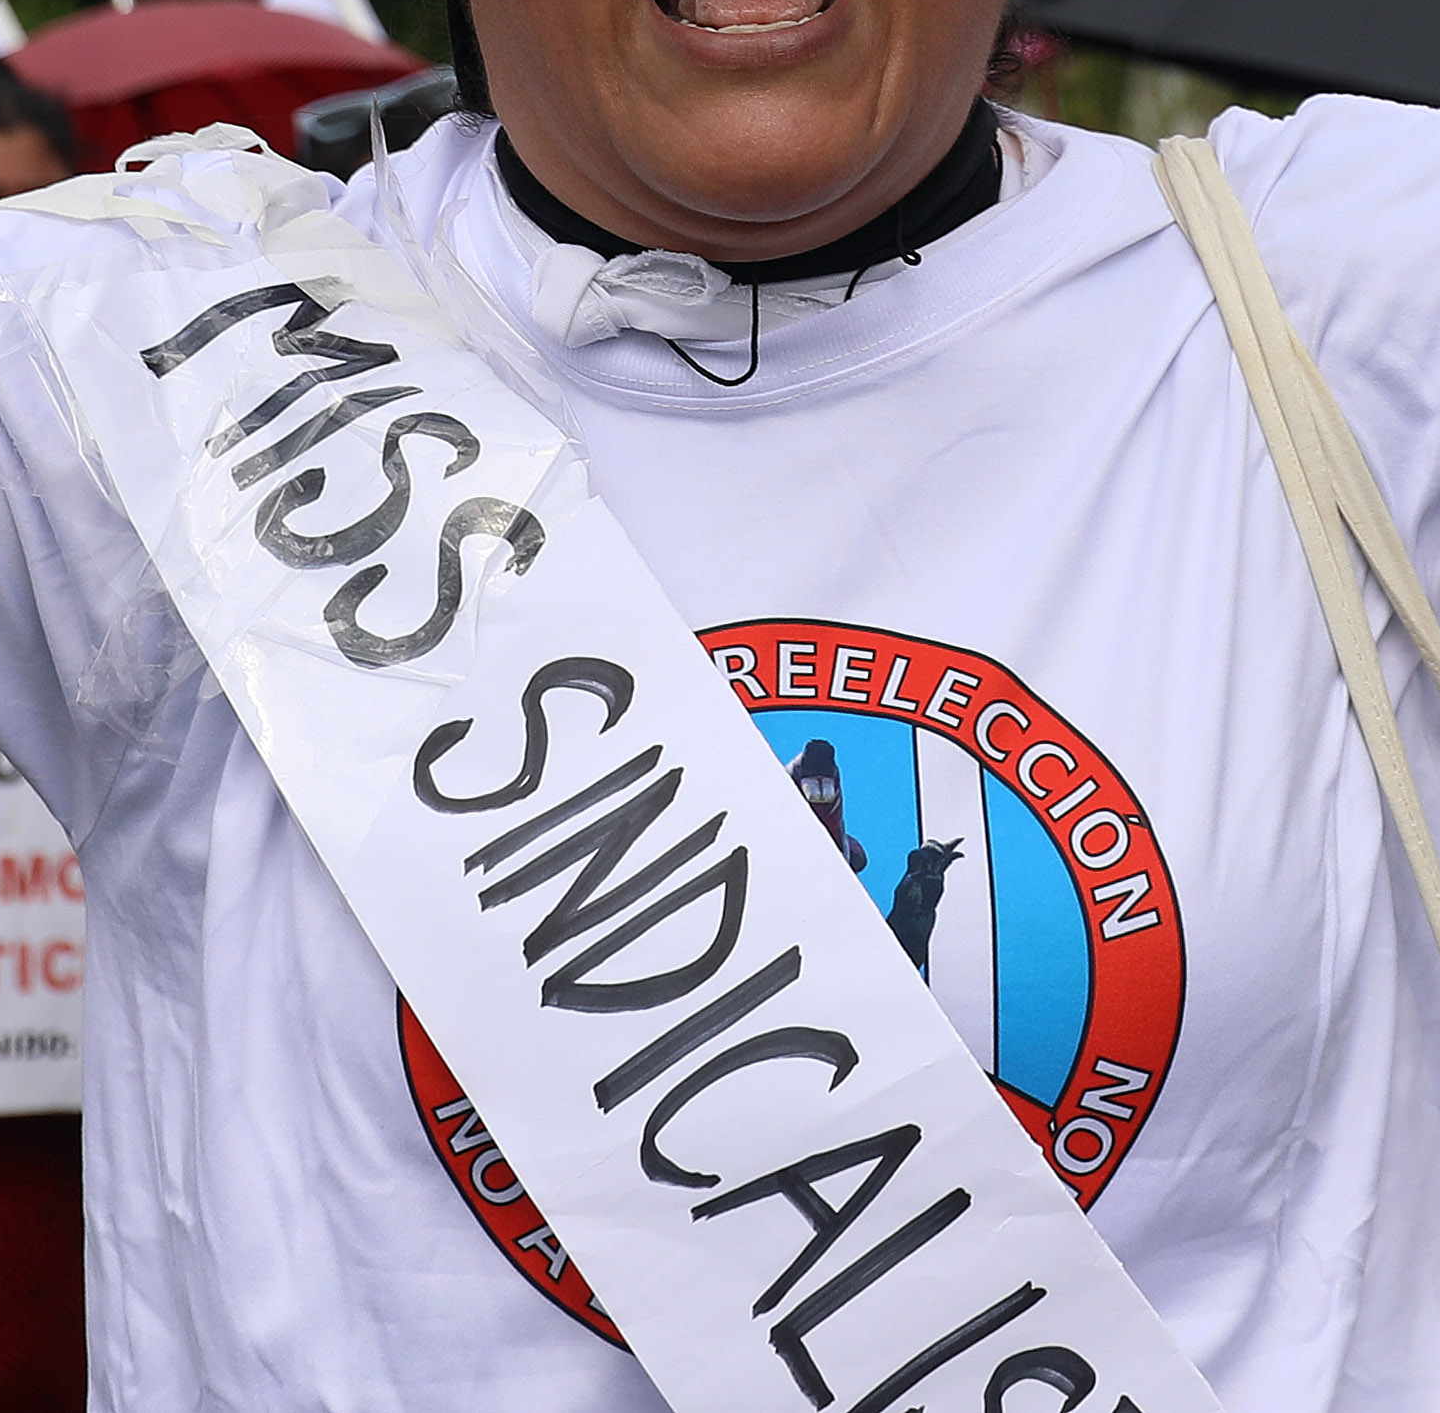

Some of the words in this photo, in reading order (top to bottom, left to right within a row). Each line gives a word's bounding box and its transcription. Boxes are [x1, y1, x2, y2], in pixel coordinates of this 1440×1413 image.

[139, 276, 546, 669] MISS
[413, 656, 1143, 1413] SINDICALI
[713, 641, 1160, 942] REELECCIÓN
[434, 1096, 526, 1205] NO
[1047, 1057, 1153, 1201] ÓN
